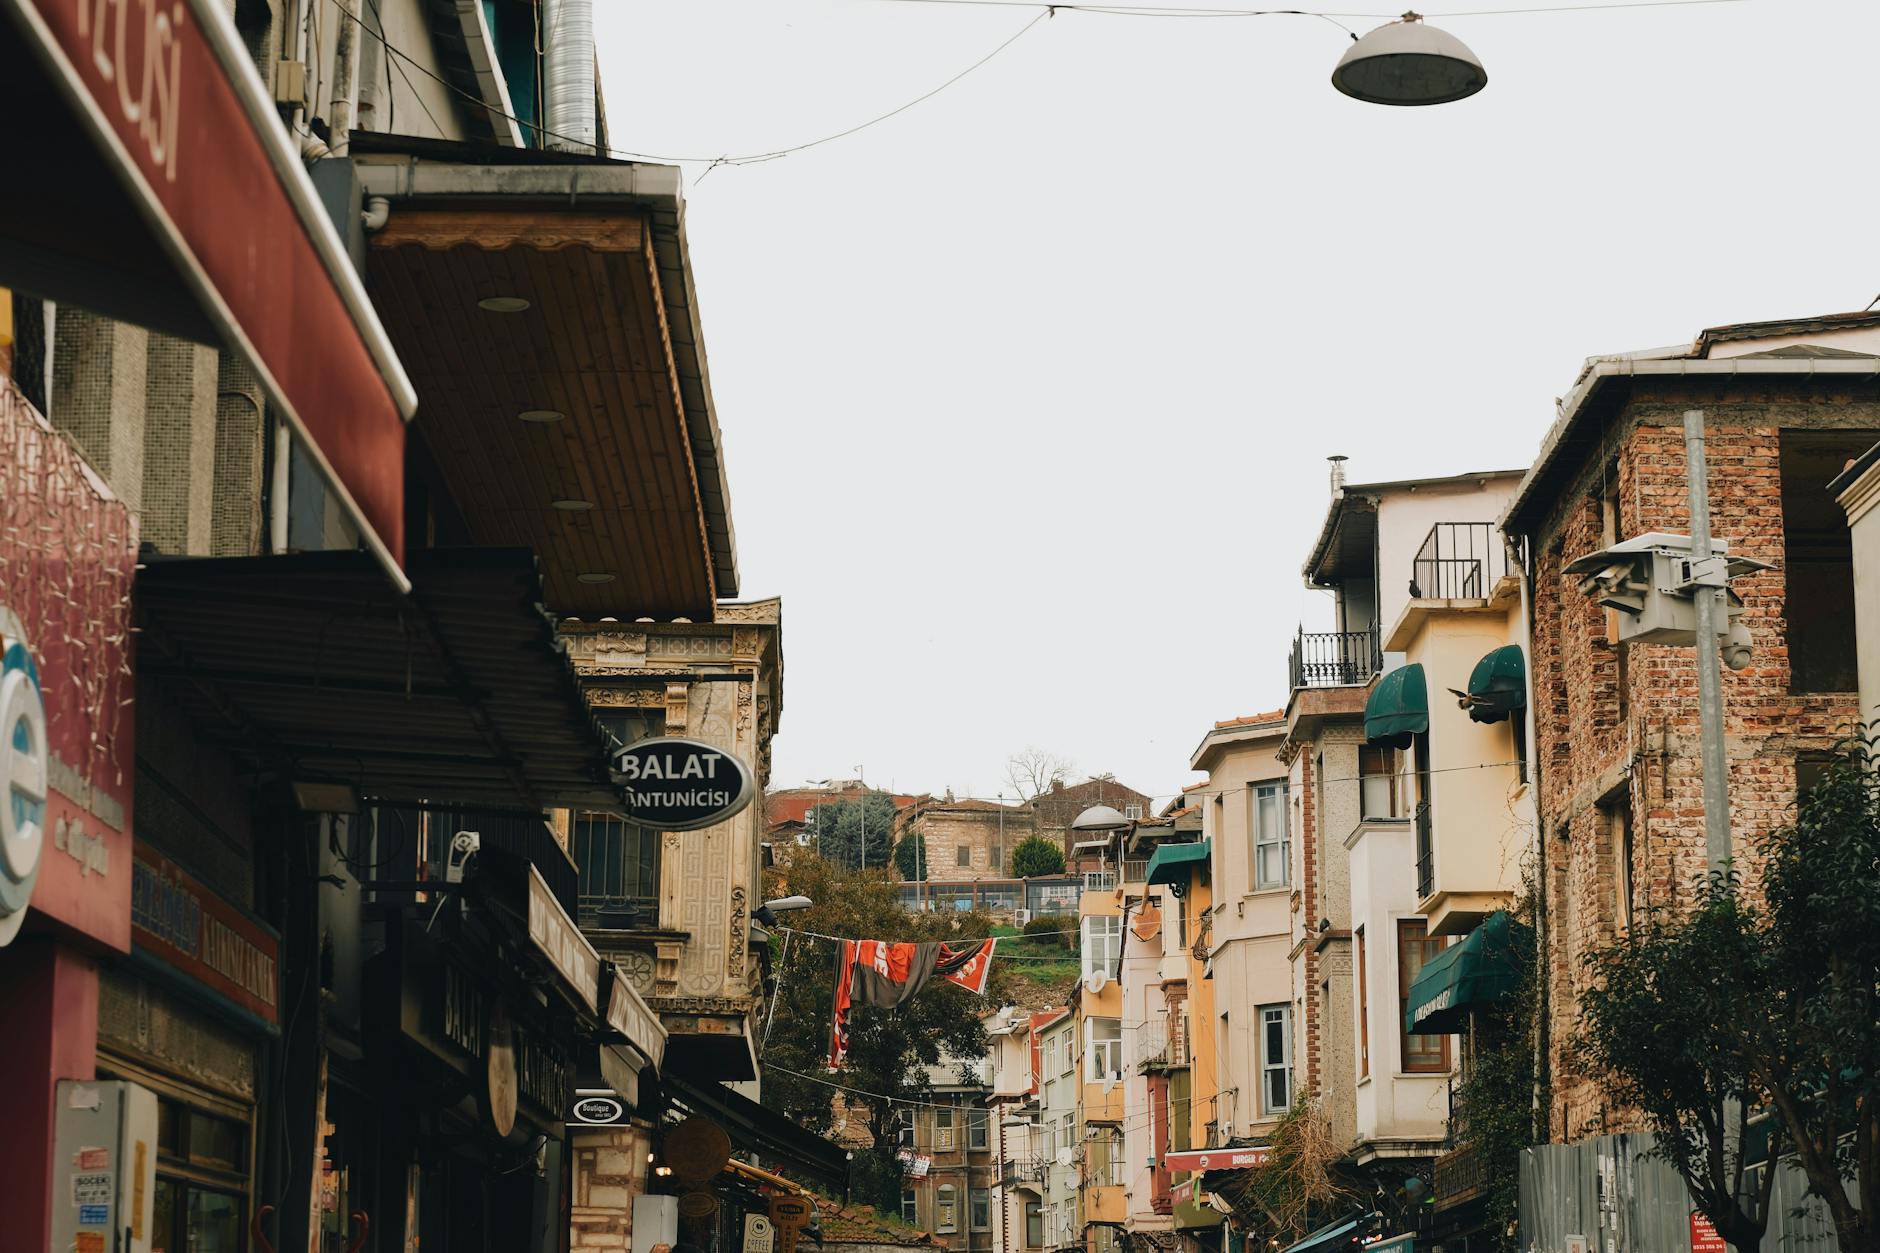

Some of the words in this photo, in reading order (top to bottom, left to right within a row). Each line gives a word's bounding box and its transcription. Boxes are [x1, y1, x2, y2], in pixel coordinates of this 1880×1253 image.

[621, 754, 722, 780] BALAT
[582, 1104, 610, 1114] Boutique
[1232, 1154, 1257, 1165] BURGER
